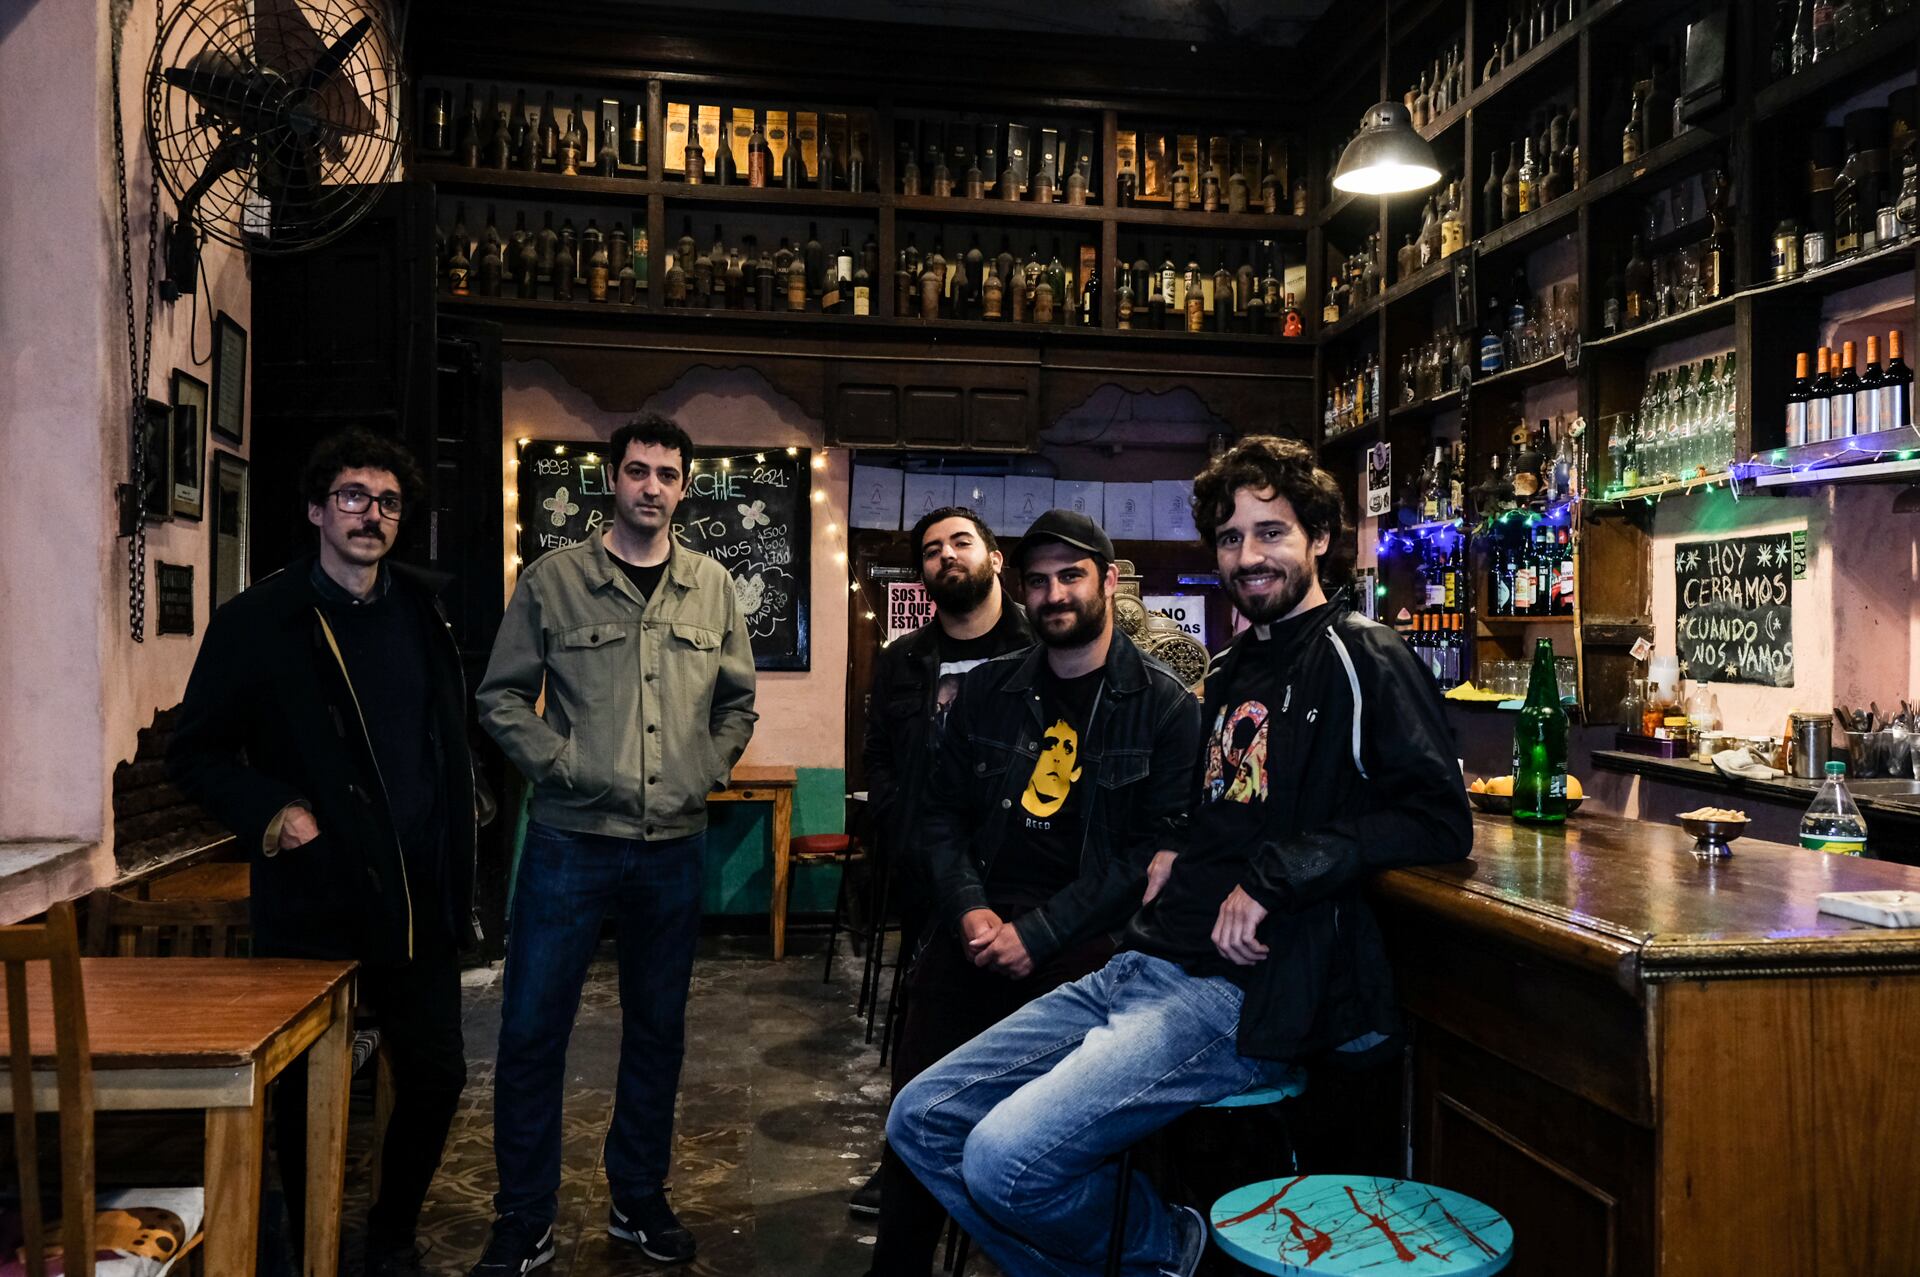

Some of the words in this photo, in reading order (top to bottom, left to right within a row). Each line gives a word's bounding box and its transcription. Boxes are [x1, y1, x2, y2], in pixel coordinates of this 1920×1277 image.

[539, 533, 577, 549] VERM
[1708, 543, 1746, 575] HOY
[891, 588, 915, 602] SOS
[1683, 573, 1788, 609] CERRAMOS
[891, 602, 905, 616] LO
[908, 602, 931, 617] QUE
[1686, 615, 1758, 642] CUANDO
[1692, 642, 1726, 669] NOS
[1738, 642, 1793, 675] VAMOS
[1025, 818, 1051, 830] REED
